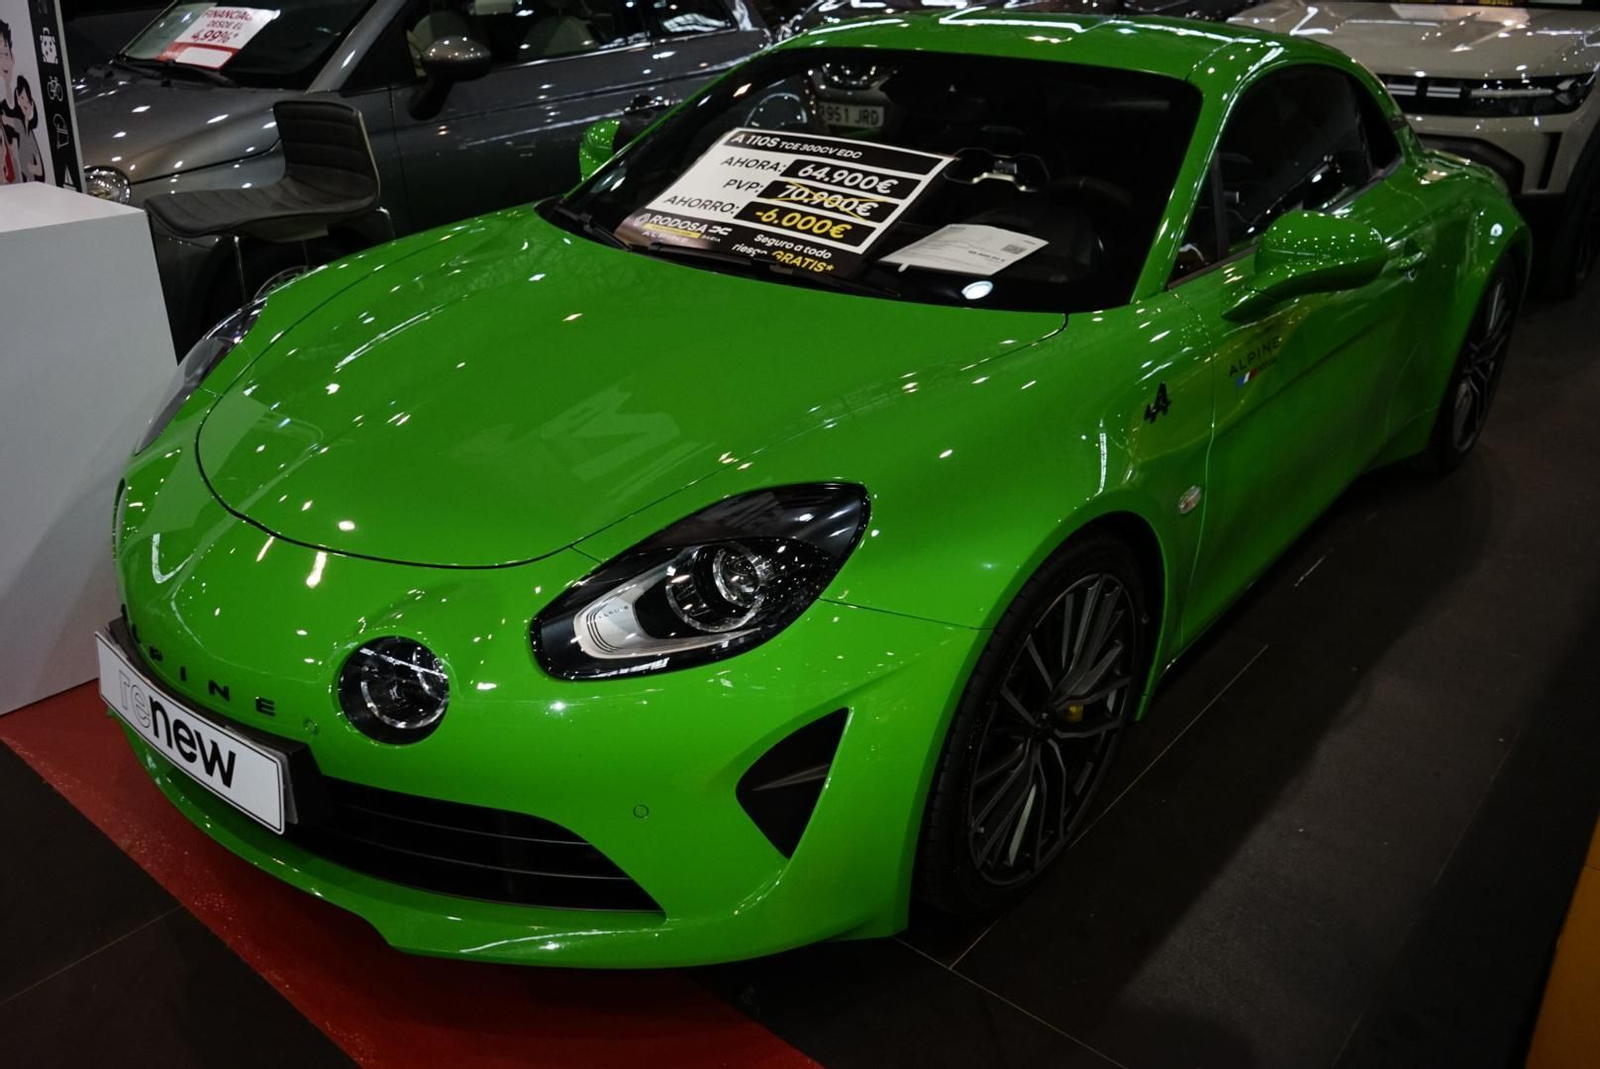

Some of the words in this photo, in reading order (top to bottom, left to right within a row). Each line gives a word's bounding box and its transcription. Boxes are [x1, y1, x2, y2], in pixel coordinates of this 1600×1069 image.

[731, 133, 744, 143] A
[746, 135, 780, 147] 110S
[780, 141, 801, 151] TCE
[800, 144, 838, 155] 300CV
[836, 148, 863, 159] EDC
[720, 156, 787, 174] AHORA:
[798, 163, 899, 194] 64.900€
[663, 195, 740, 215] AHORRO:
[754, 208, 853, 239] -6.000€
[722, 179, 764, 193] PVP:
[777, 185, 879, 217] 70.900€
[650, 214, 708, 234] RODOSA
[754, 233, 794, 249] Seguro
[795, 244, 803, 252] a
[803, 245, 832, 260] todo
[1228, 336, 1280, 377] ALPINE
[118, 669, 237, 788] renew
